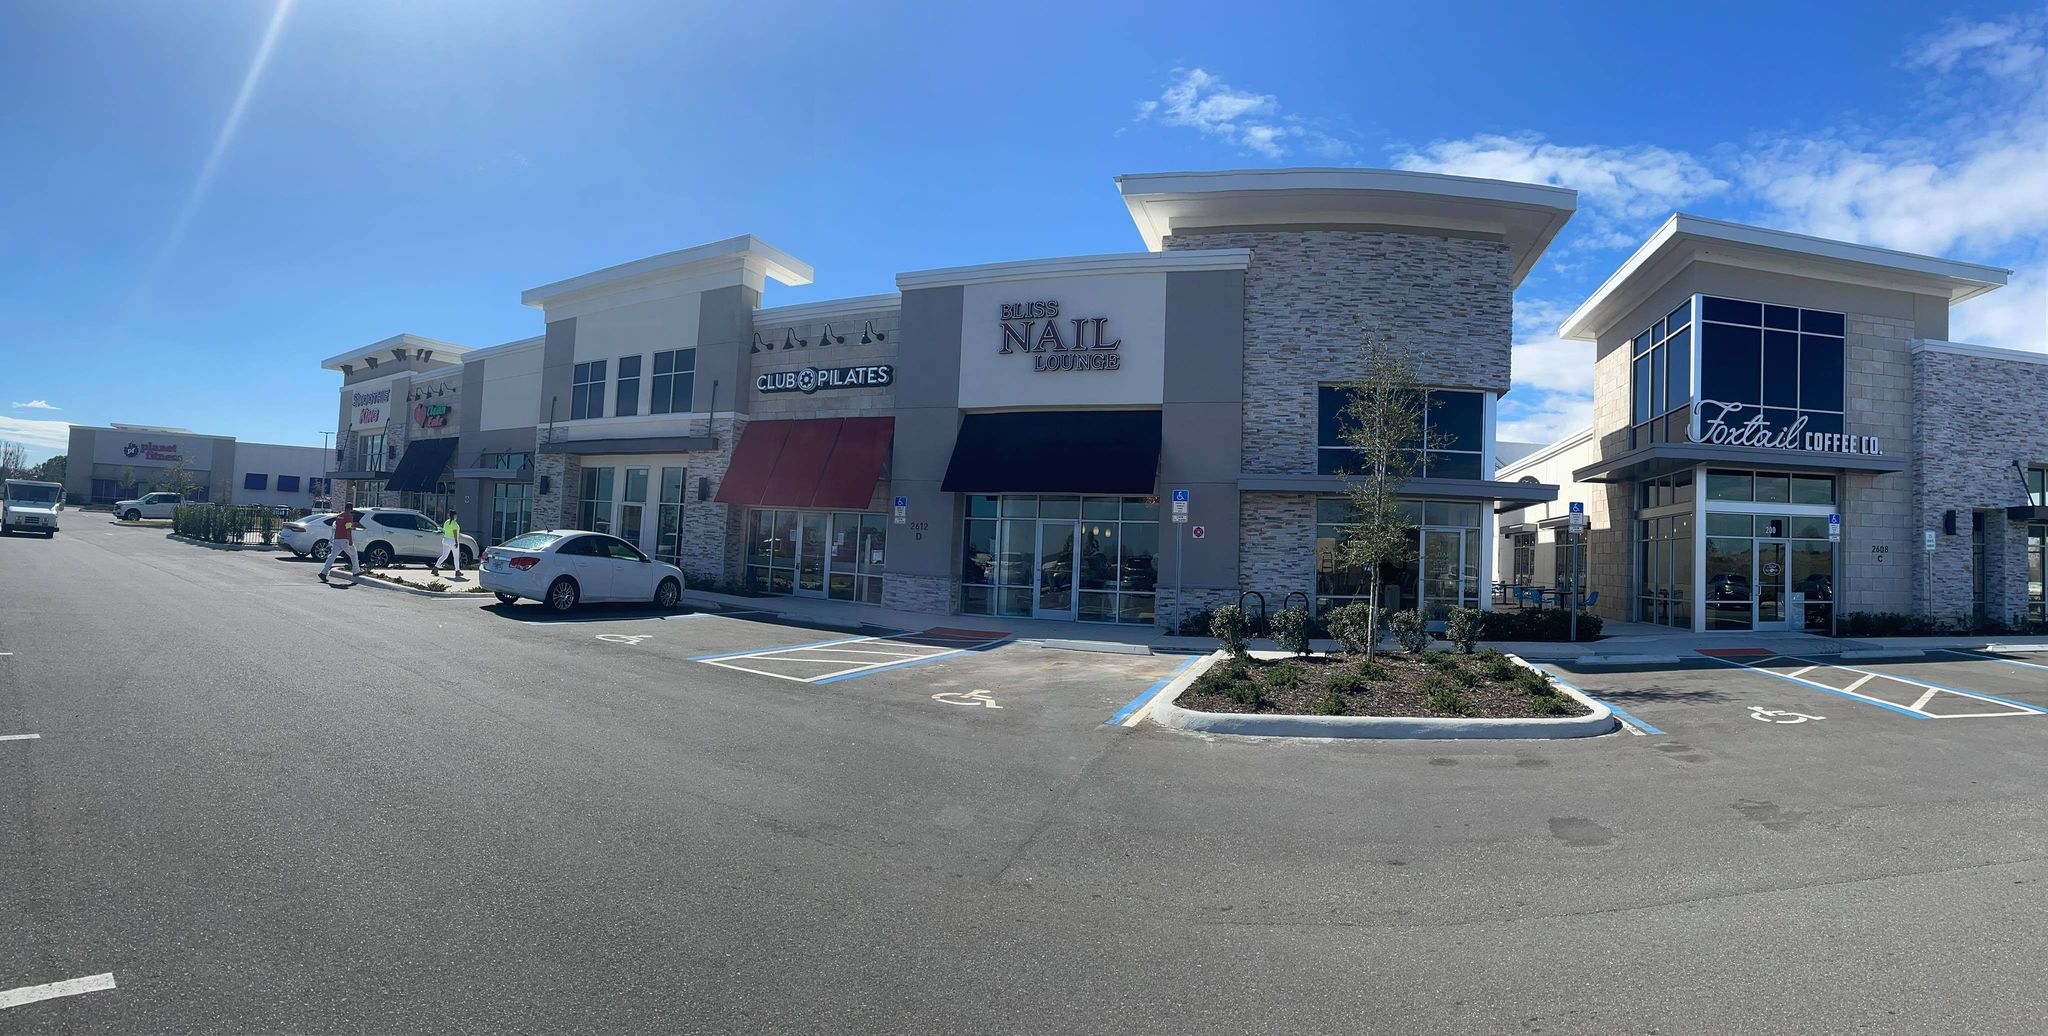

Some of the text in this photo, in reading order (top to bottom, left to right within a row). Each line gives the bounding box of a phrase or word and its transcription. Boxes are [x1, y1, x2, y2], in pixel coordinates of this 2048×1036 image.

[1000, 300, 1060, 320] BLISS
[999, 318, 1121, 354] NAIL
[1034, 353, 1121, 372] LOUNGE
[756, 366, 889, 390] CLUB PILATES
[1685, 399, 1883, 455] Foxtail COFFEE CO.
[140, 442, 177, 453] planet
[910, 522, 929, 531] 2612
[1765, 526, 1776, 534] 200
[915, 532, 922, 541] D
[1871, 545, 1889, 553] 2608
